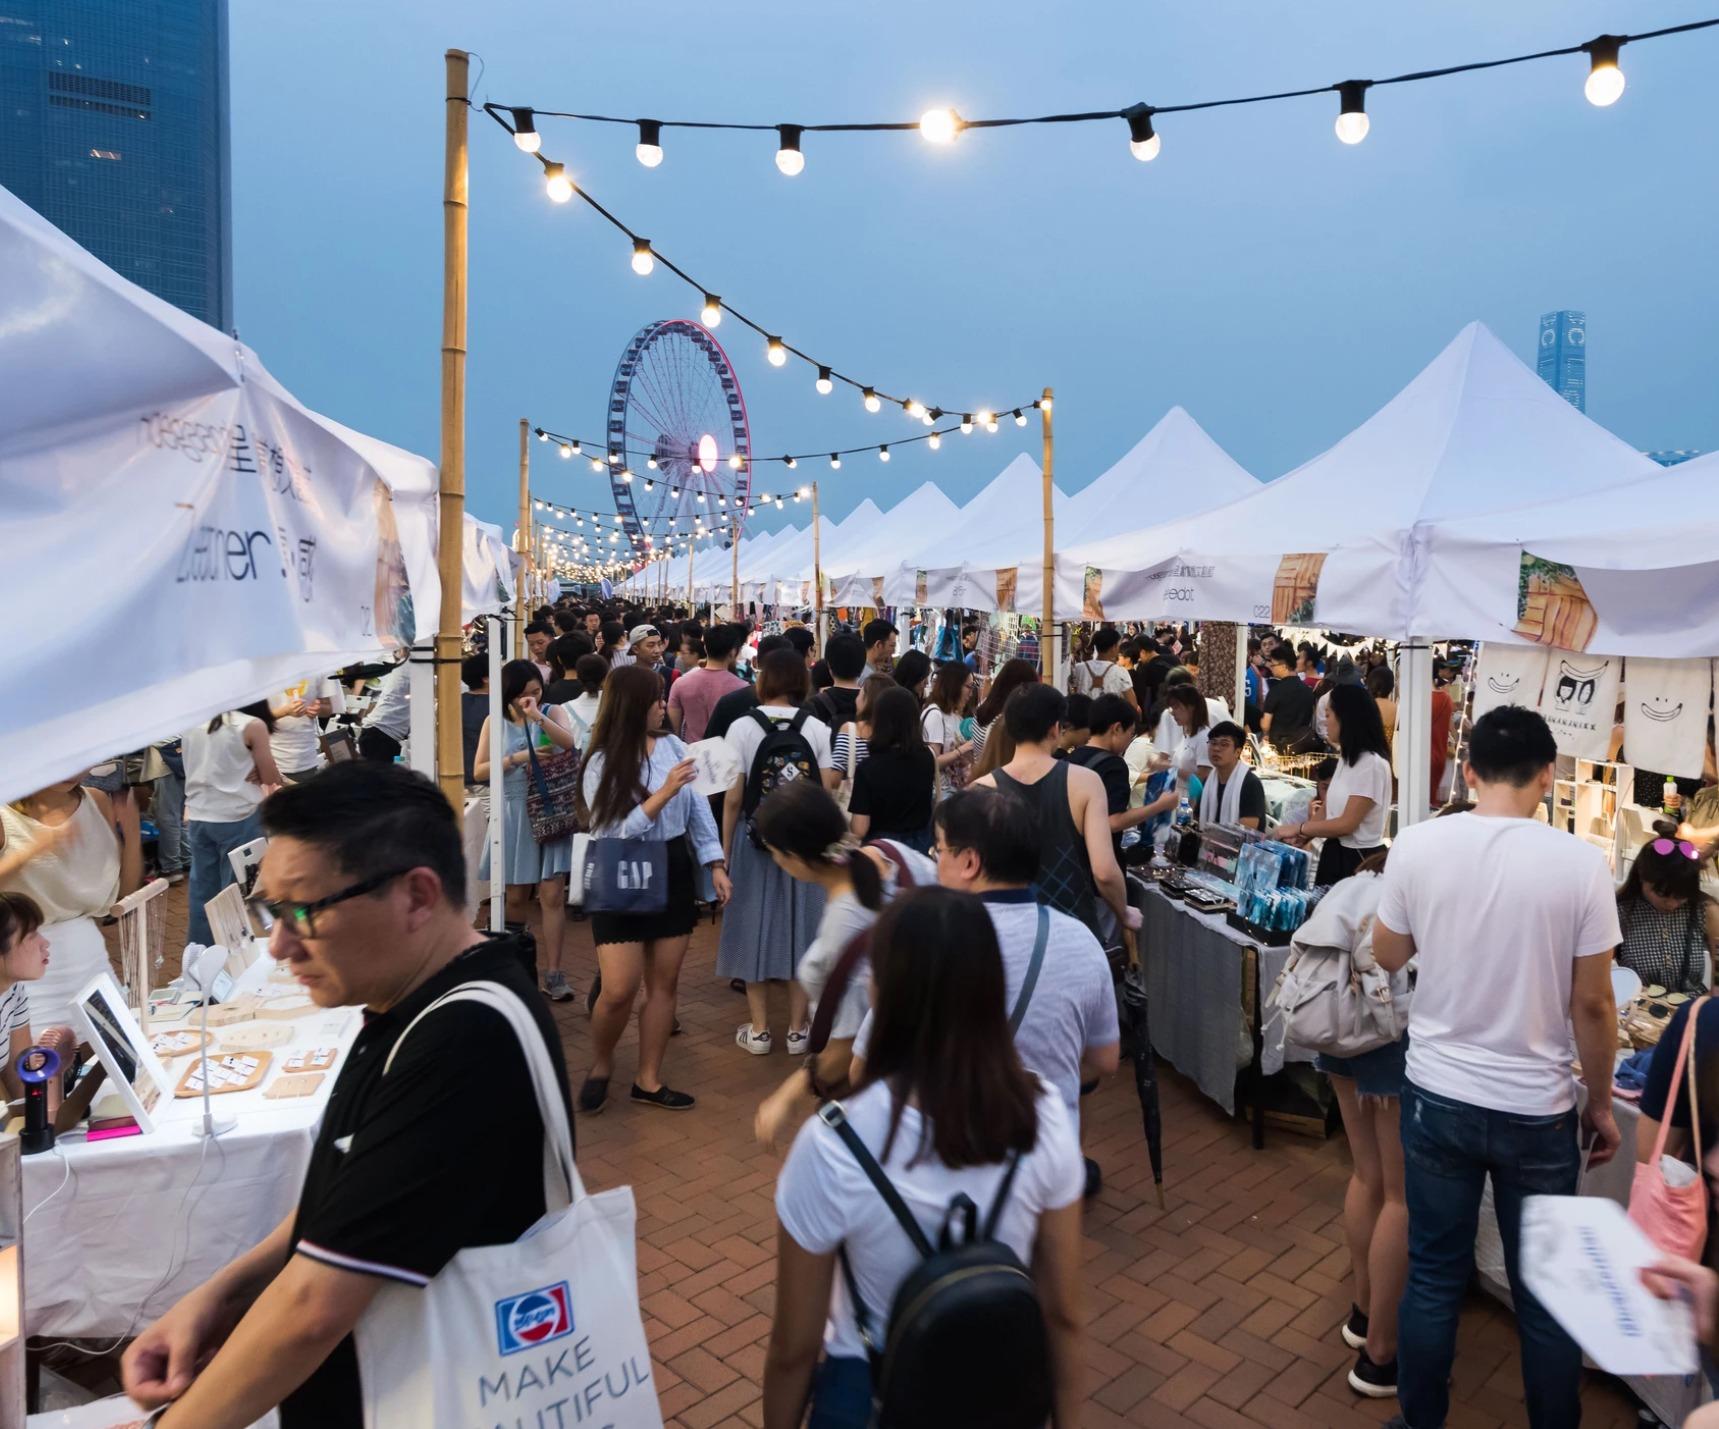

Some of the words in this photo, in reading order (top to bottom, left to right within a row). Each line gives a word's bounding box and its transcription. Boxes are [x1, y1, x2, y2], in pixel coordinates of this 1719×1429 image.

[617, 860, 653, 890] GAP
[478, 1335, 595, 1407] MAKE
[494, 1357, 650, 1429] TIFUL
